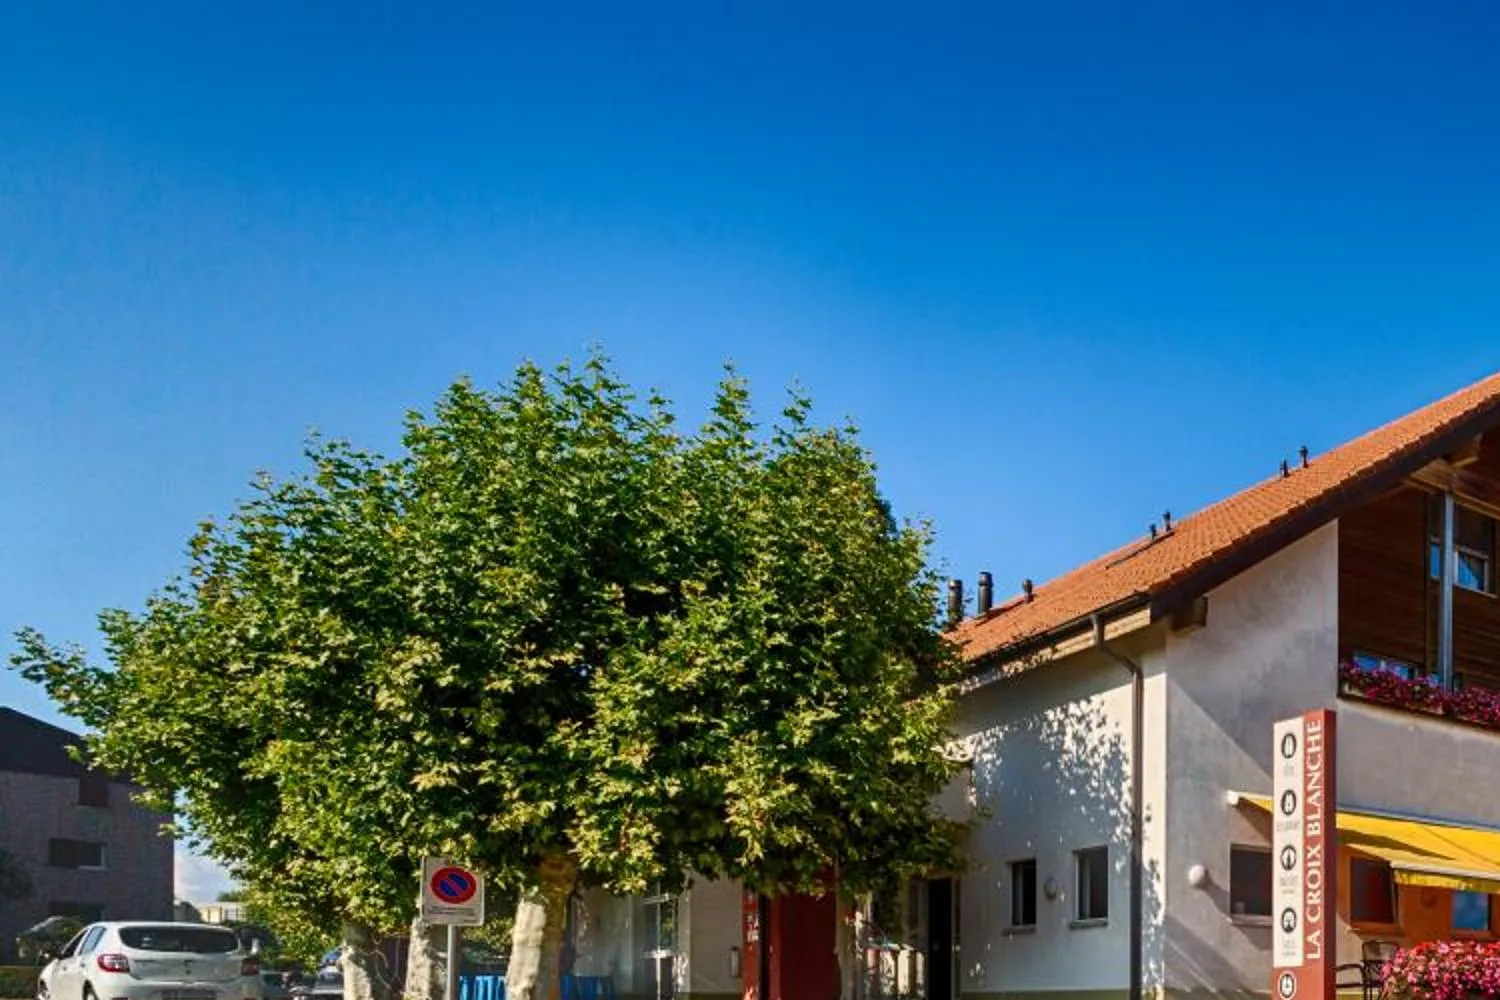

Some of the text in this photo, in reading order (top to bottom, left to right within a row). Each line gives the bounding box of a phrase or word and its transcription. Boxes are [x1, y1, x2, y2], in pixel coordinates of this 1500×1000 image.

[1305, 718, 1322, 959] LA CROIX BLANCHE
